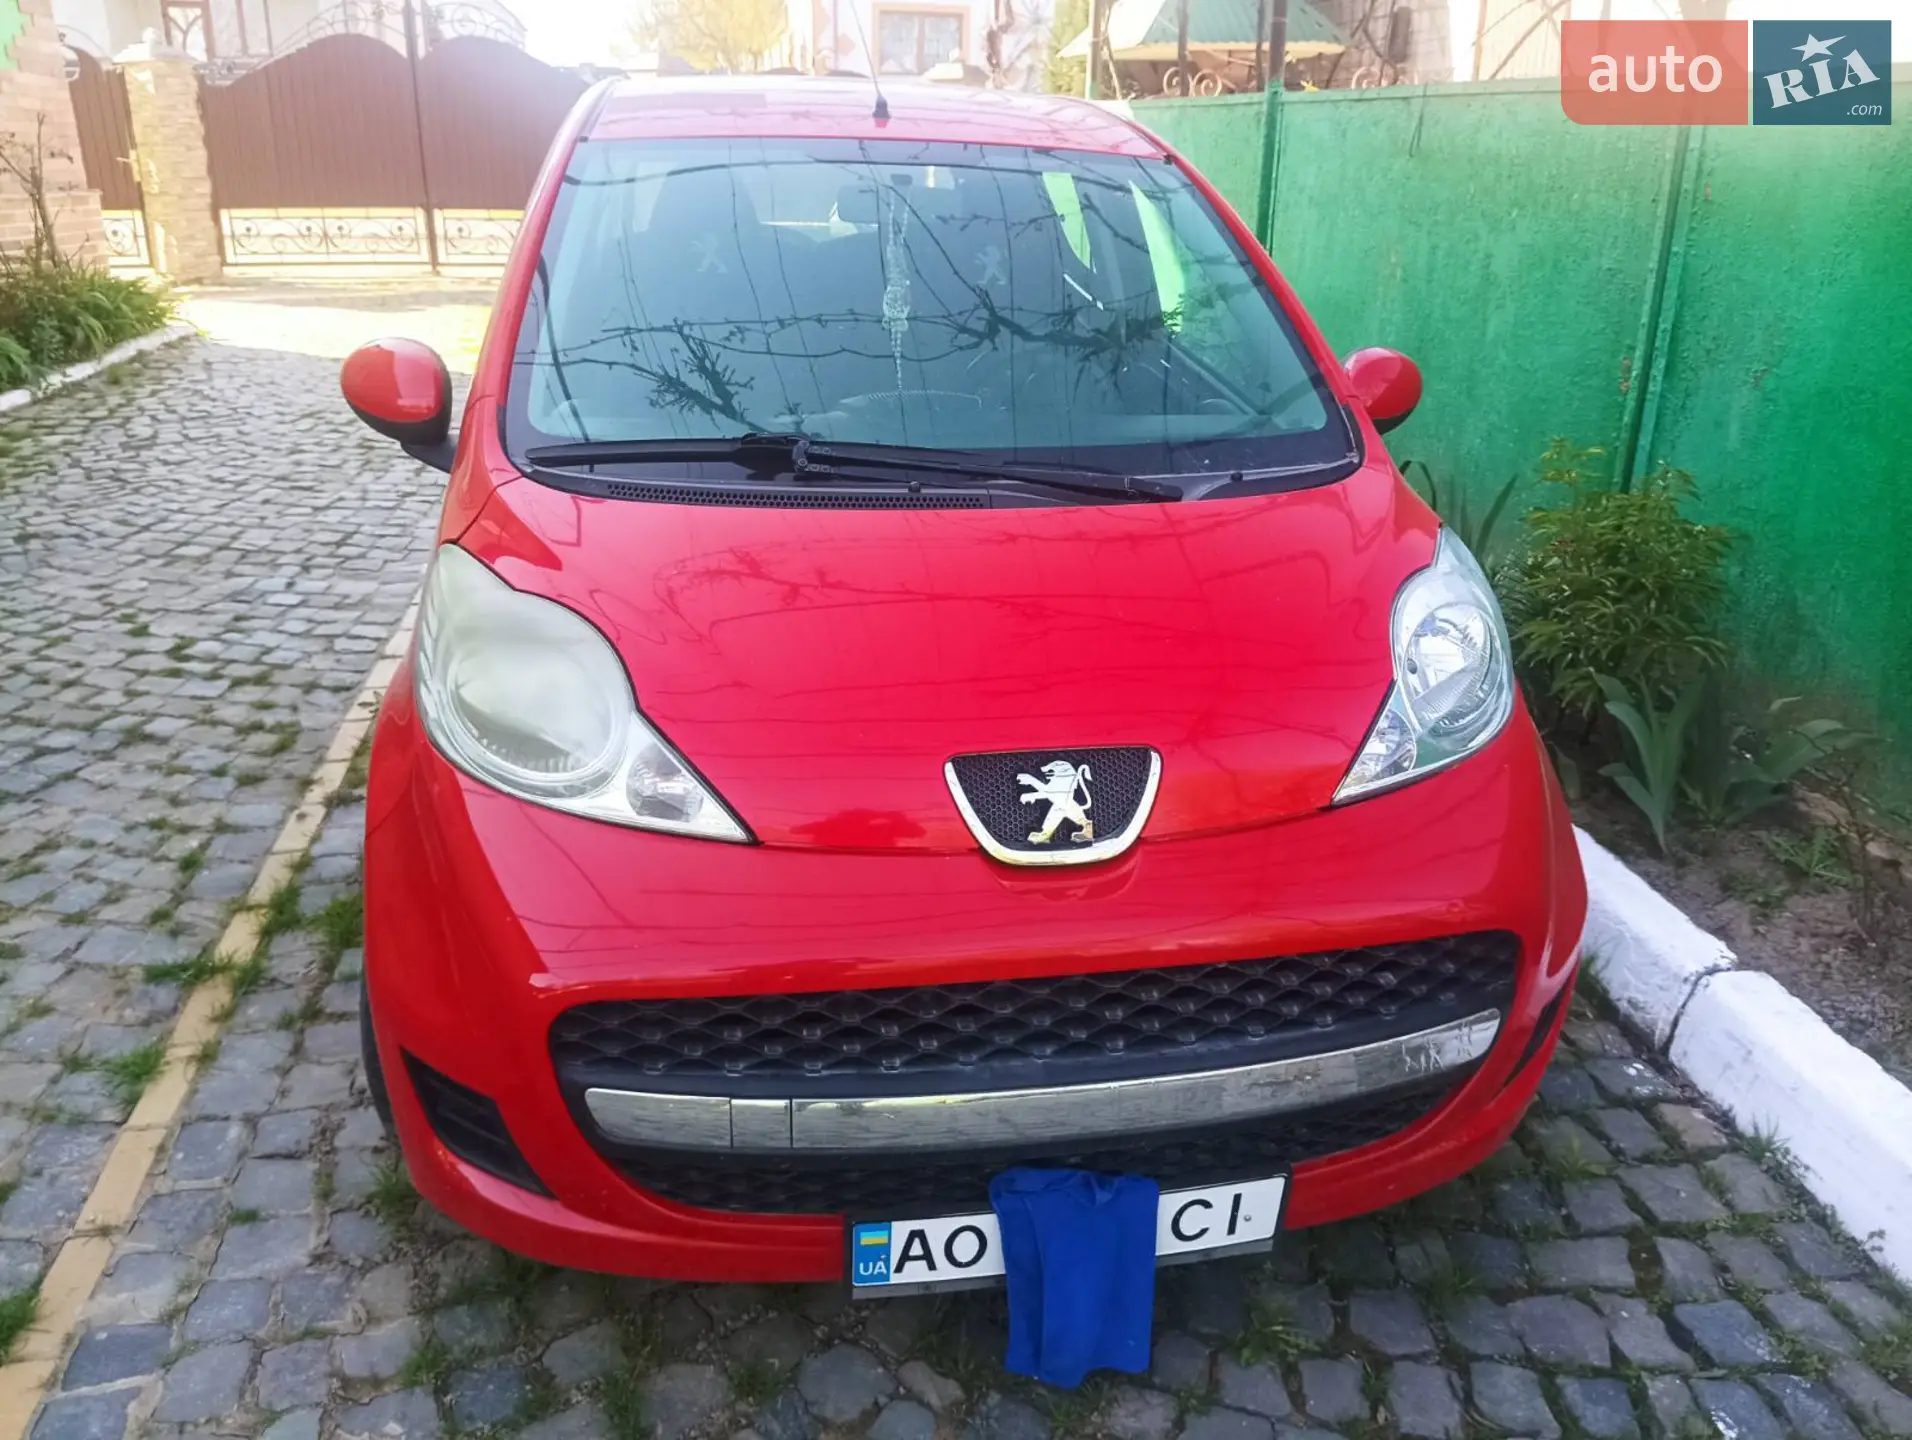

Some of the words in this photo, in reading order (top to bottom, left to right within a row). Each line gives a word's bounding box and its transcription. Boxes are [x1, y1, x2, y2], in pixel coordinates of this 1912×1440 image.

[893, 1224, 988, 1274] AO
[1170, 1193, 1243, 1243] CI
[859, 1260, 888, 1277] UA
